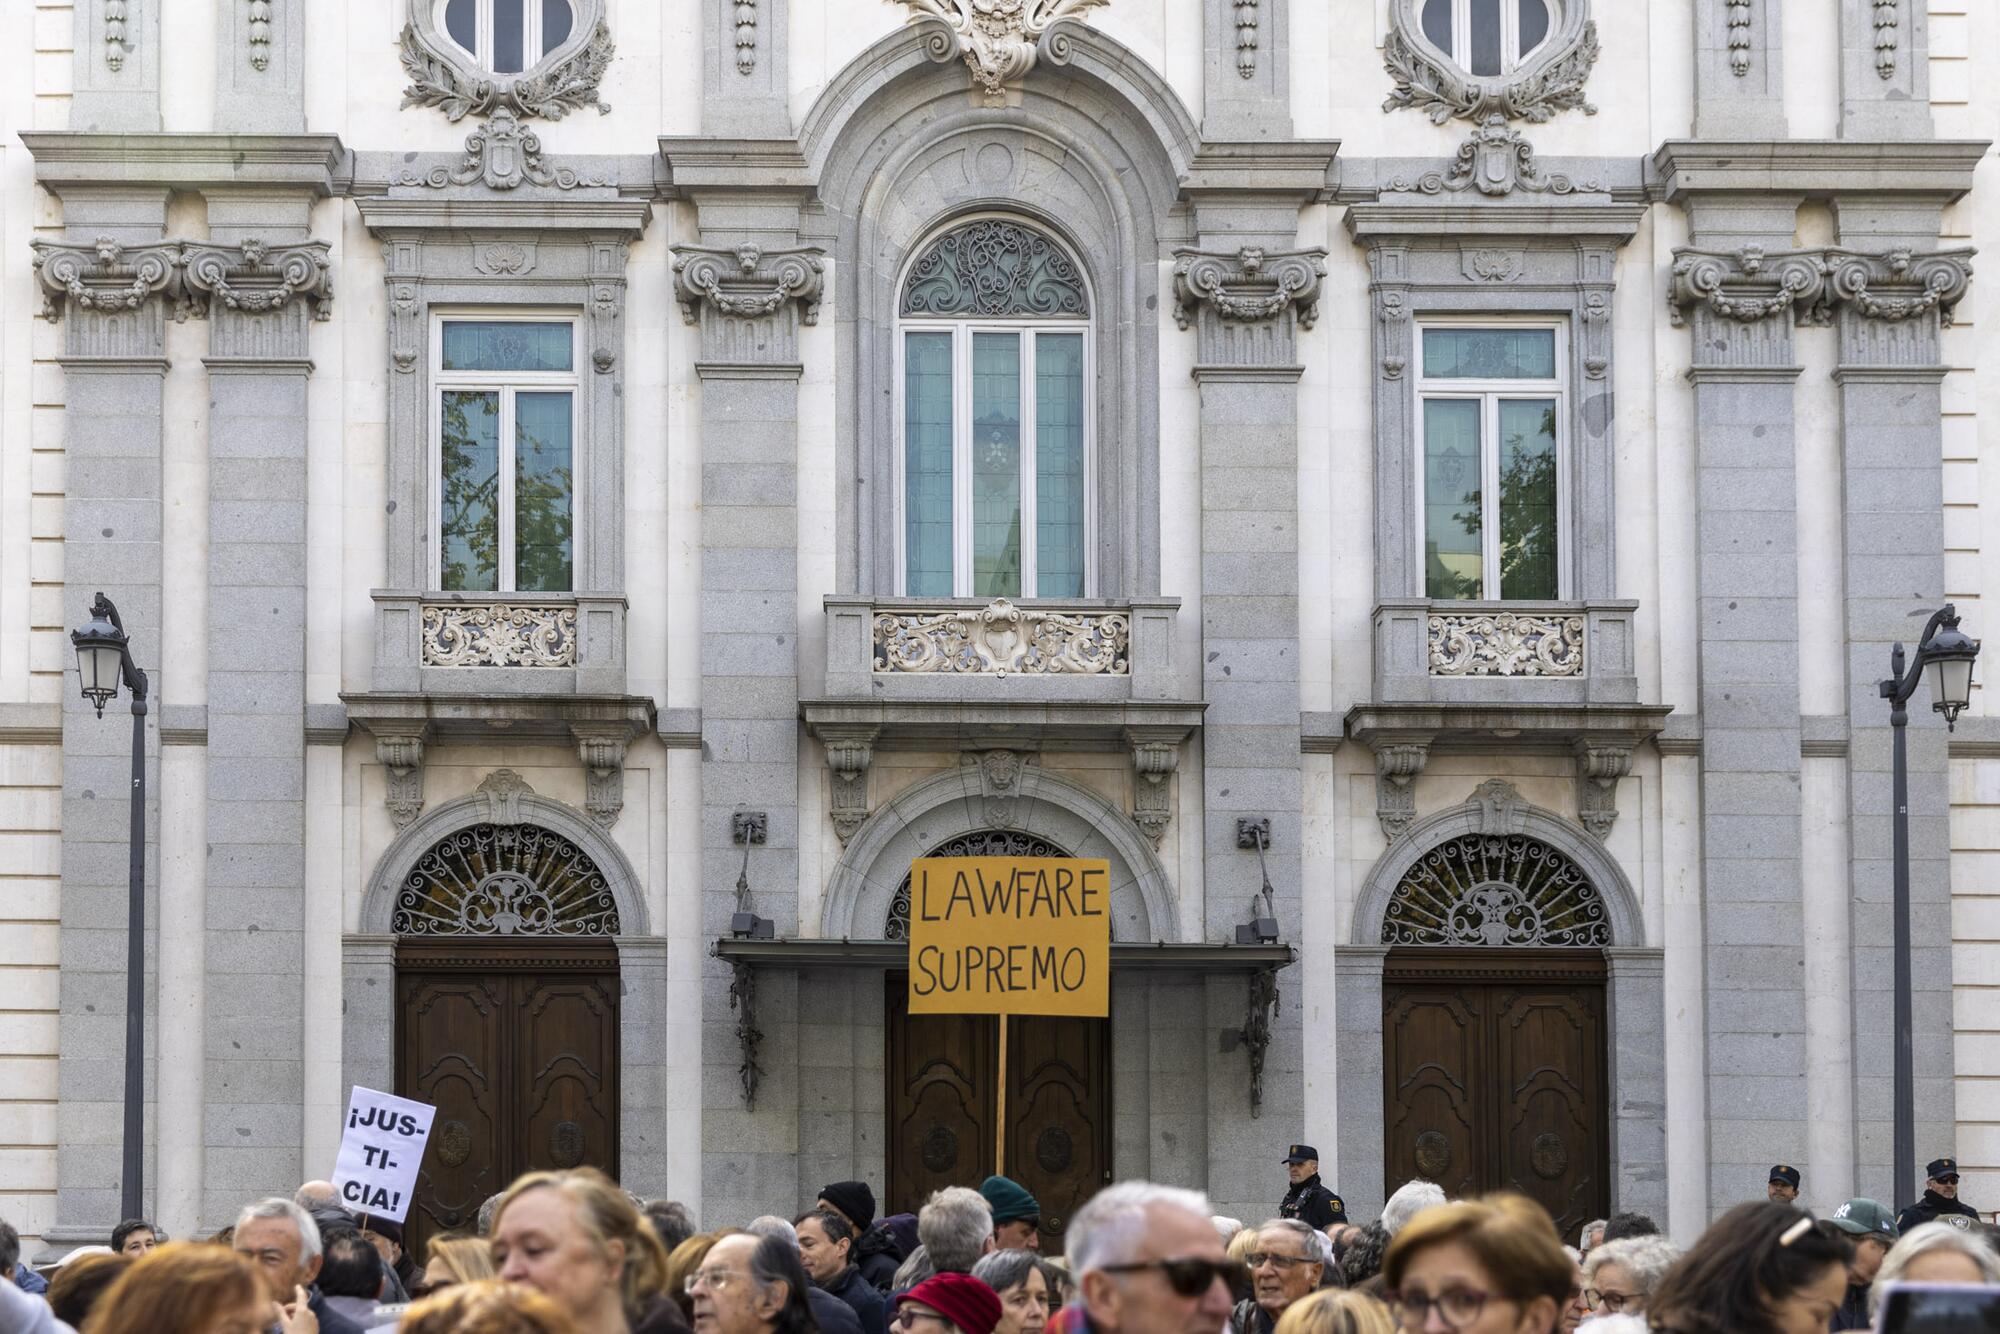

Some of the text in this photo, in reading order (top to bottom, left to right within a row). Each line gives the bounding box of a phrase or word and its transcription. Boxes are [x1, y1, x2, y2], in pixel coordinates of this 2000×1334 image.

[921, 867, 1105, 922] LAWFARE
[914, 945, 1086, 996] SUPREMO
[348, 1106, 425, 1136] ¡JUS-
[363, 1144, 398, 1170] TI-
[342, 1180, 401, 1212] CIA!
